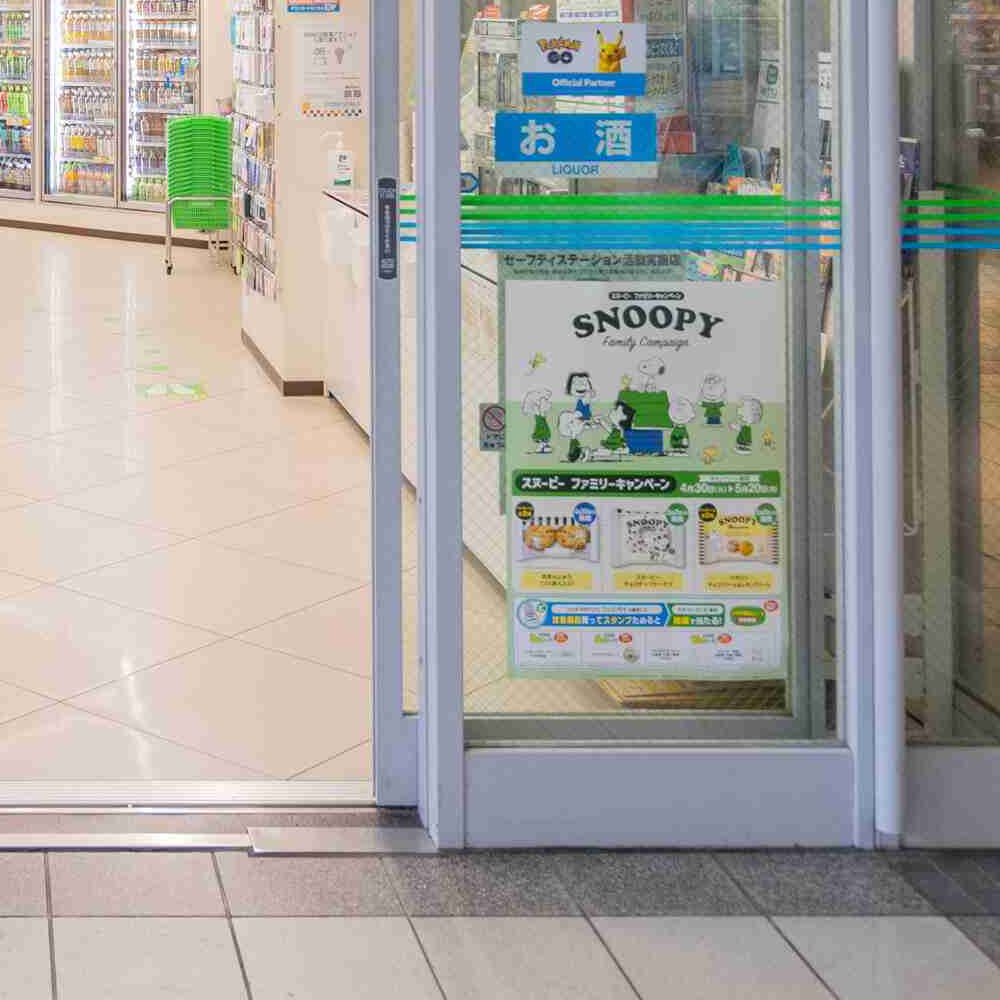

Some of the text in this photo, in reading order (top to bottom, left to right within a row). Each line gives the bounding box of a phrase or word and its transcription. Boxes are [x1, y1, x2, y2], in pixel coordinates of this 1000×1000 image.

[547, 51, 573, 64] GO
[552, 78, 617, 88] Official Partner
[552, 164, 600, 176] LIQUOR
[572, 304, 724, 339] SNOOPY
[602, 335, 689, 352] Family Campaign
[521, 476, 670, 490] スヌーピー ファミリーキャンペーン
